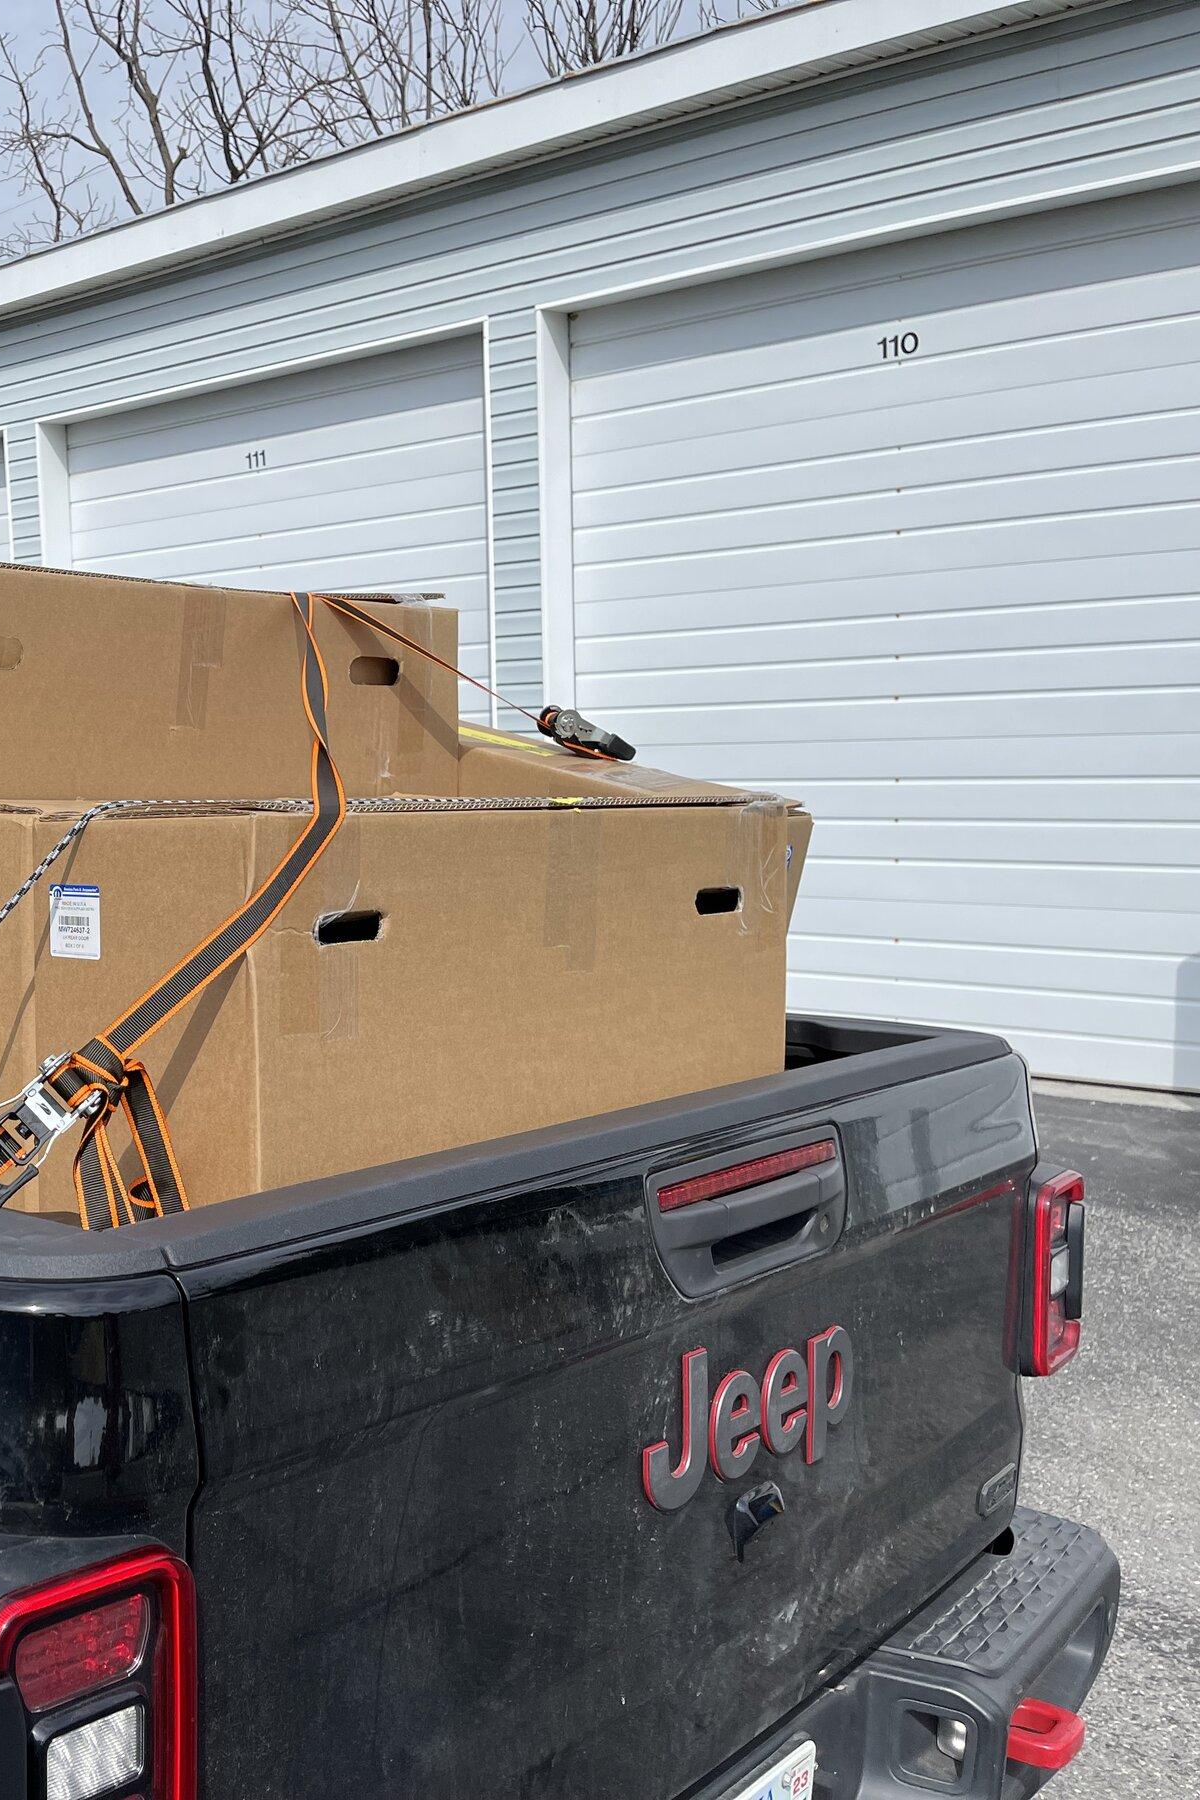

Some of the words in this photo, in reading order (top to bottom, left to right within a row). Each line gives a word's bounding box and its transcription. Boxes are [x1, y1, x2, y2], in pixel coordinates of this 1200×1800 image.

[877, 332, 919, 359] 110
[245, 450, 266, 469] 111
[643, 1323, 853, 1511] Jeep
[793, 1770, 809, 1795] 23
